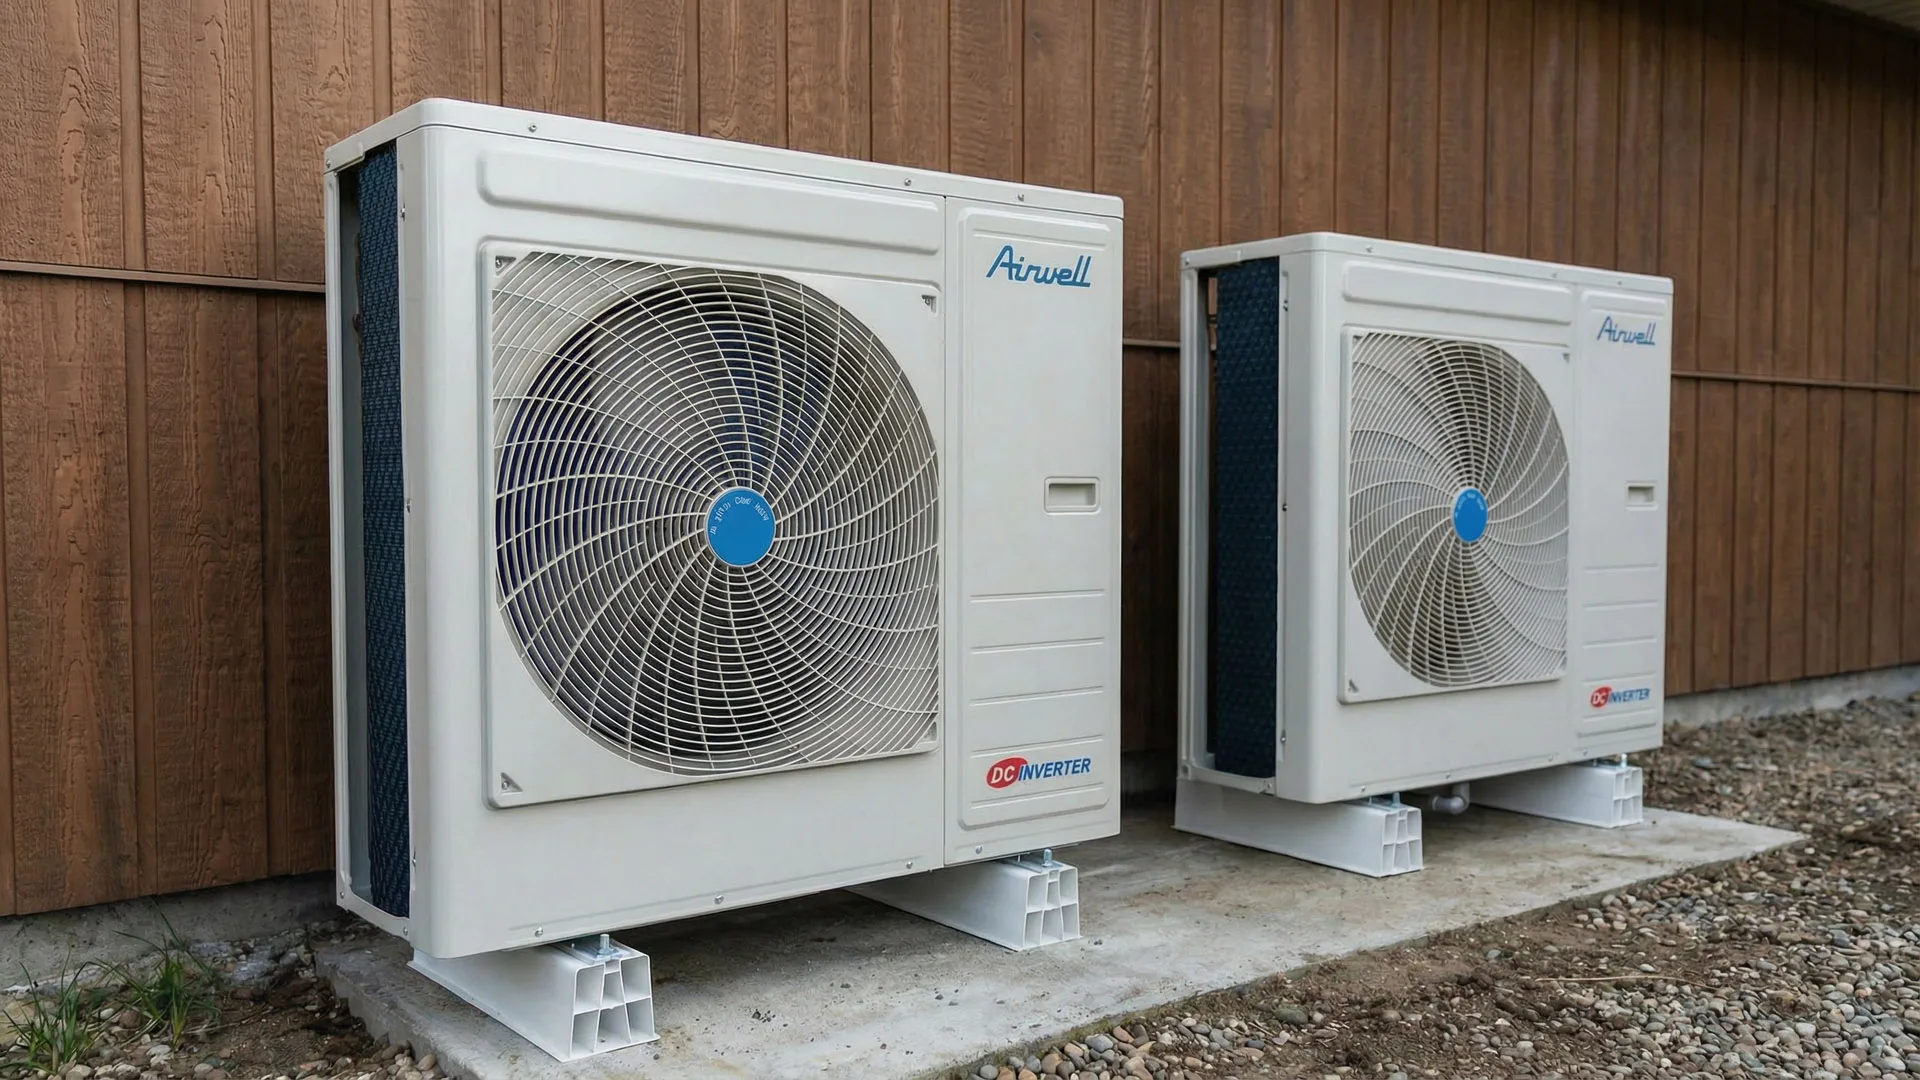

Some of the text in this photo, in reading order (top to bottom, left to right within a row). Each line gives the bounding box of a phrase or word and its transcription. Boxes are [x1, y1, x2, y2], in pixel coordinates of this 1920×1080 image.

[986, 245, 1092, 288] Airwell
[1597, 316, 1657, 346] Airwell
[990, 758, 1092, 784] DC INVERTER
